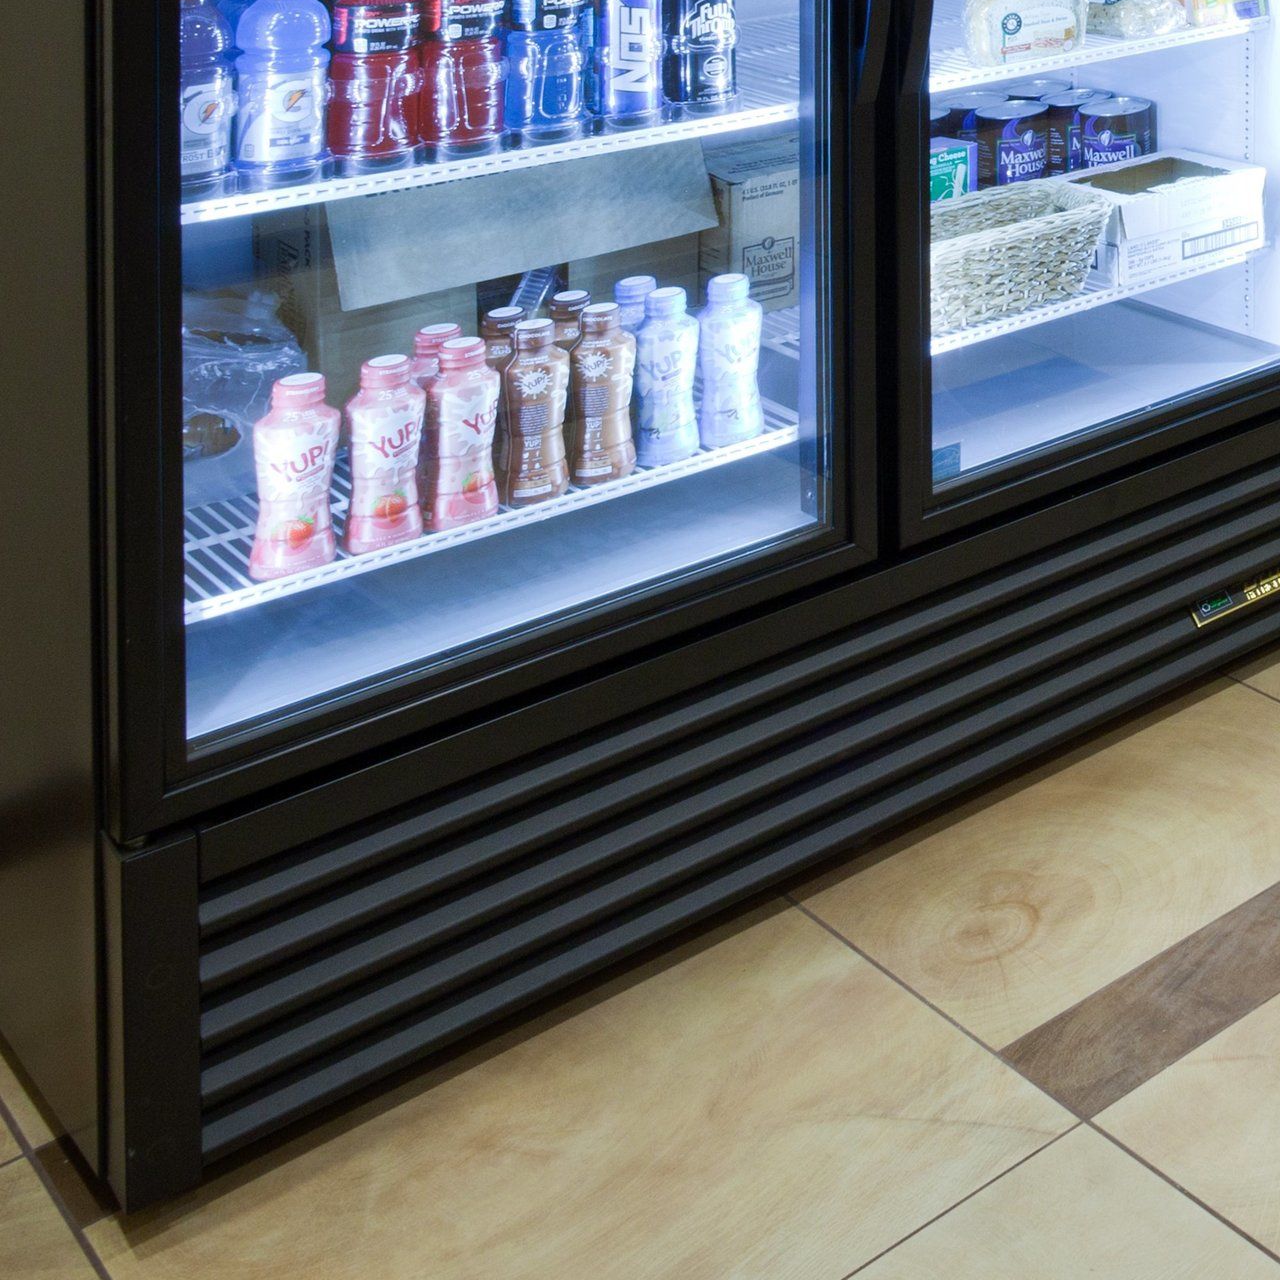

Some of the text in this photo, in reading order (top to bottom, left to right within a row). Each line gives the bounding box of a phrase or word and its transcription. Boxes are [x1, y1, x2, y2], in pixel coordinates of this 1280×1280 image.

[609, 4, 651, 94] NOS
[937, 150, 966, 162] Cheese
[1084, 144, 1136, 163] Maxwell
[745, 246, 793, 268] Maxwell
[751, 260, 788, 278] House
